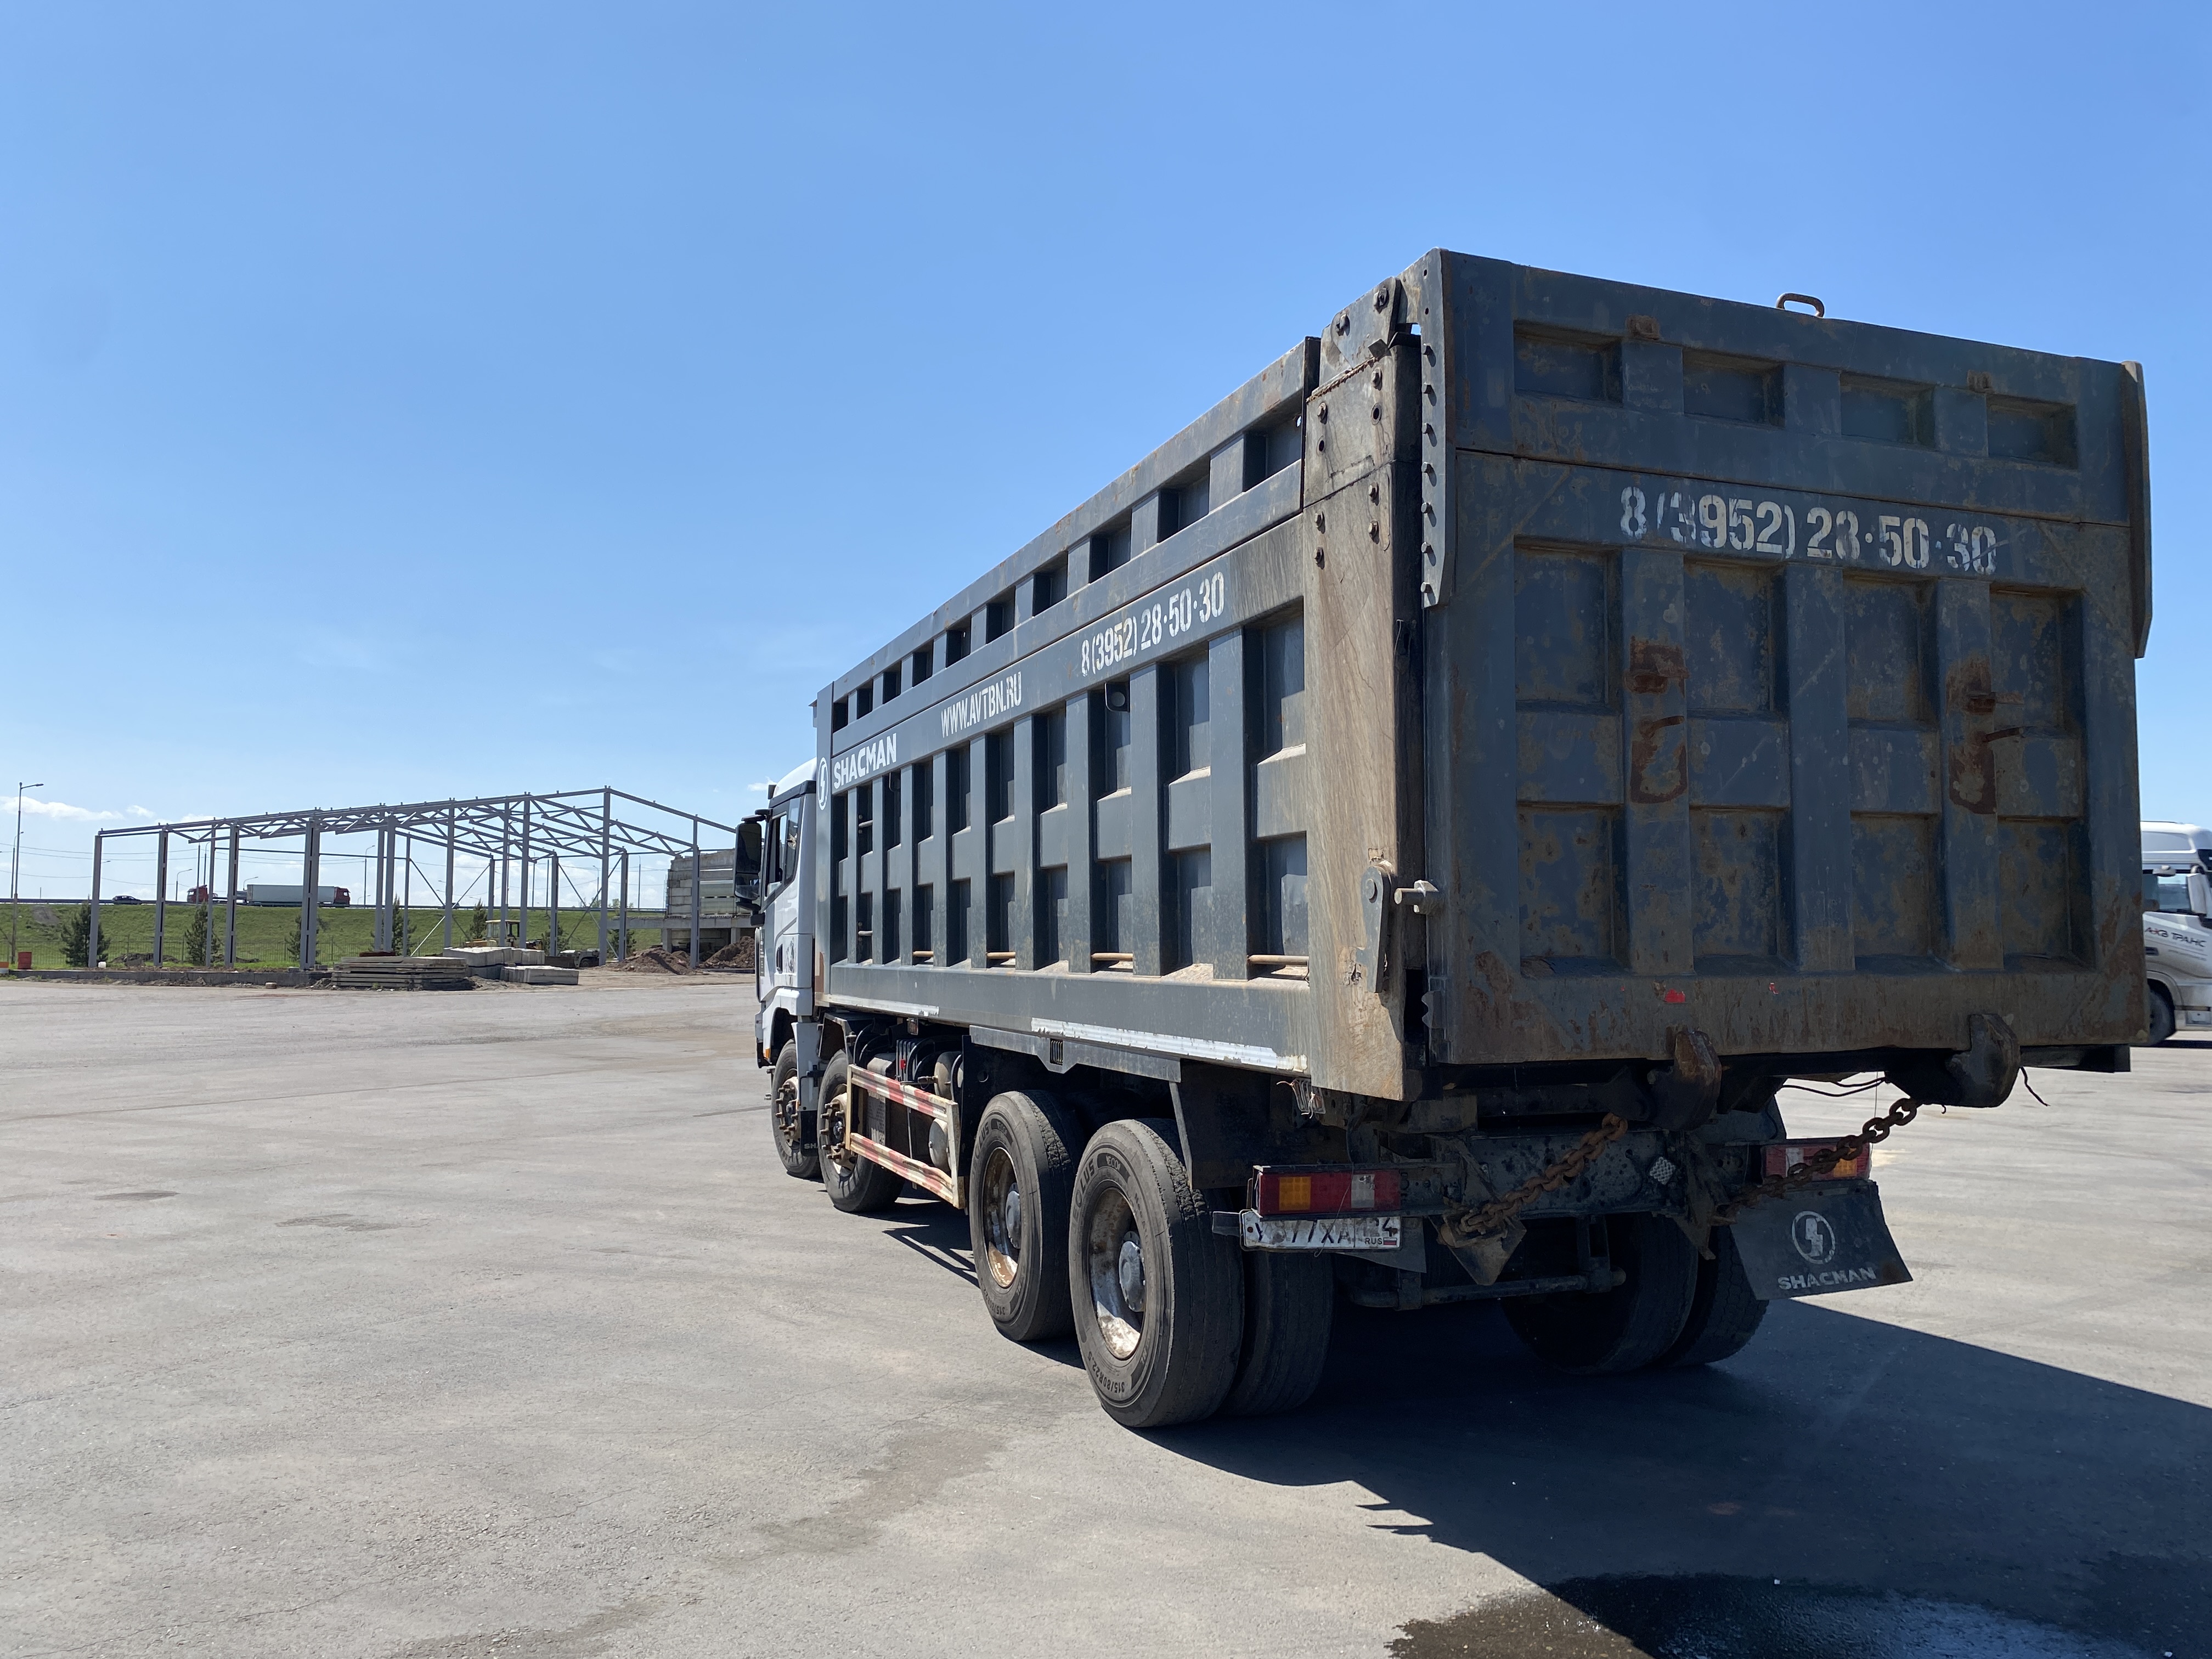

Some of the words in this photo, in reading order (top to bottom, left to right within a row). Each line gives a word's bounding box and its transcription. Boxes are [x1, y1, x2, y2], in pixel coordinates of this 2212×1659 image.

[941, 671, 1022, 738] WWW.AVTBN.RU
[833, 732, 898, 789] SHACMAN
[1778, 1267, 1877, 1290] SHACMAN
